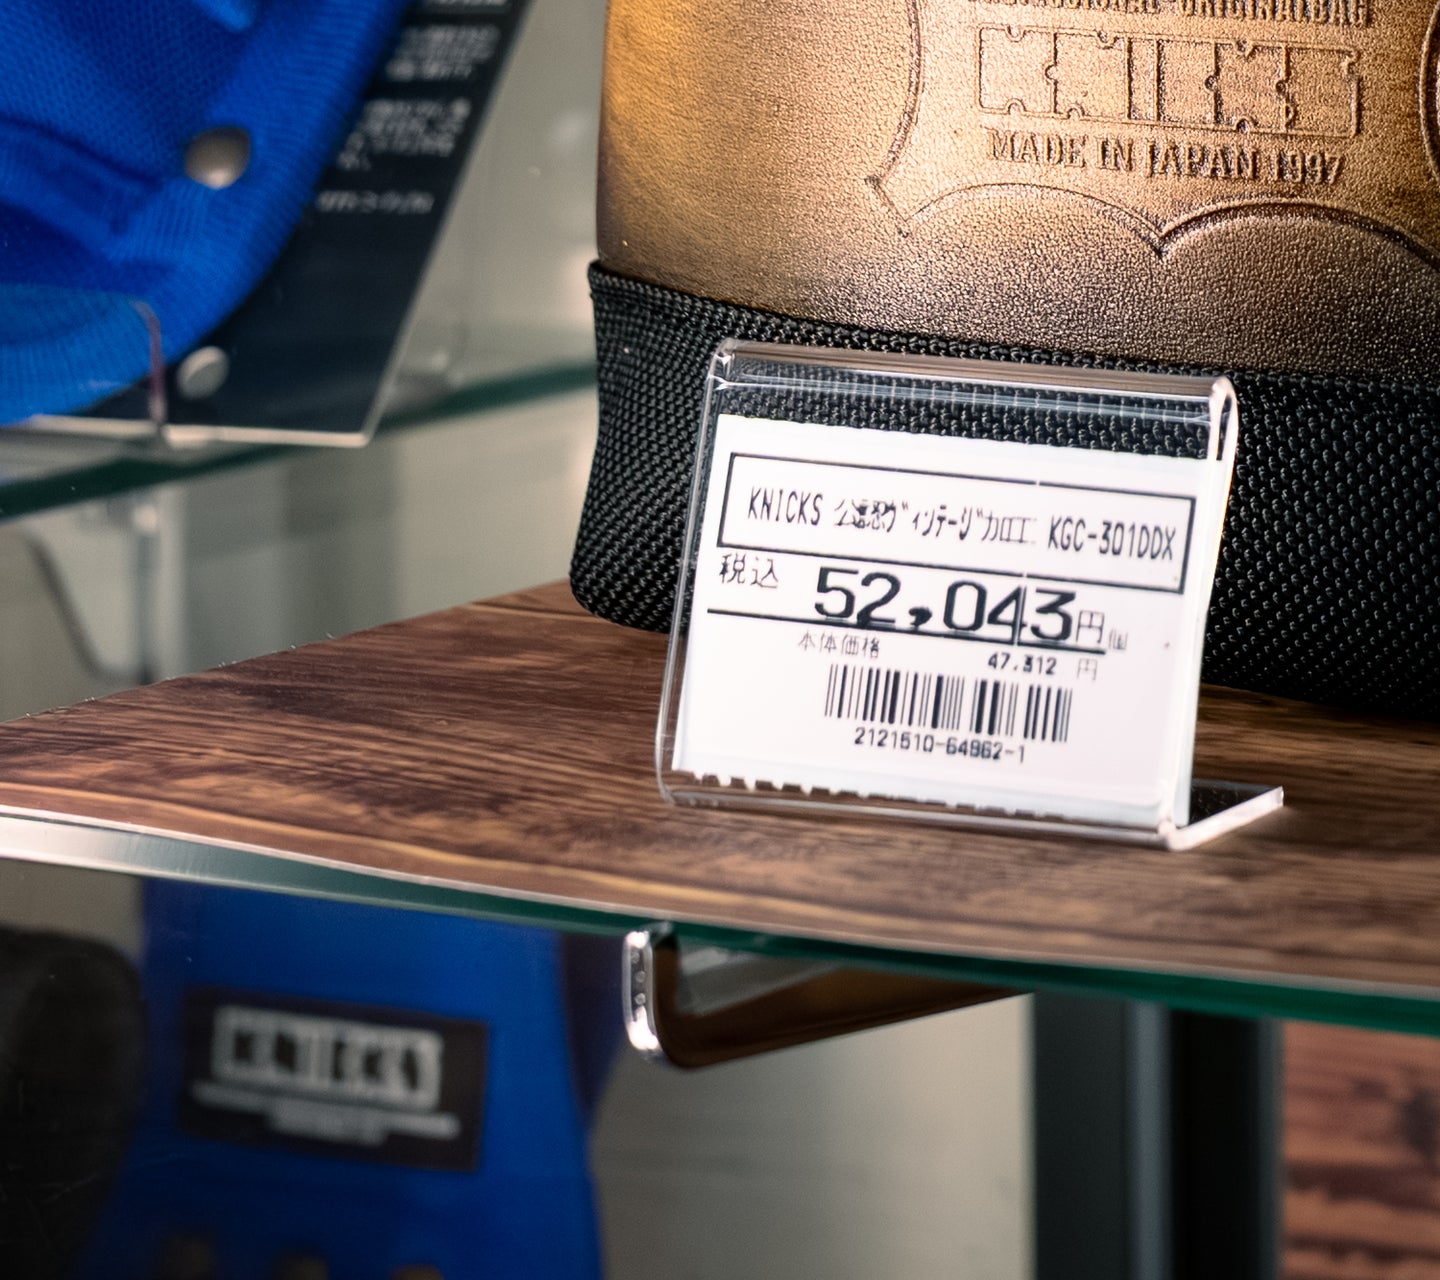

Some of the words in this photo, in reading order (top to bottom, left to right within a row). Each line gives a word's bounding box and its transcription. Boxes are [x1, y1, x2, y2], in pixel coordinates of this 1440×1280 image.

[987, 127, 1086, 168] MADE
[1097, 140, 1134, 171] IN
[1145, 140, 1262, 182] JAPAN
[747, 486, 823, 526] KNICKS
[1047, 514, 1177, 560] KGC-301DDX
[719, 552, 779, 589] 税込
[798, 631, 881, 659] 本体価格
